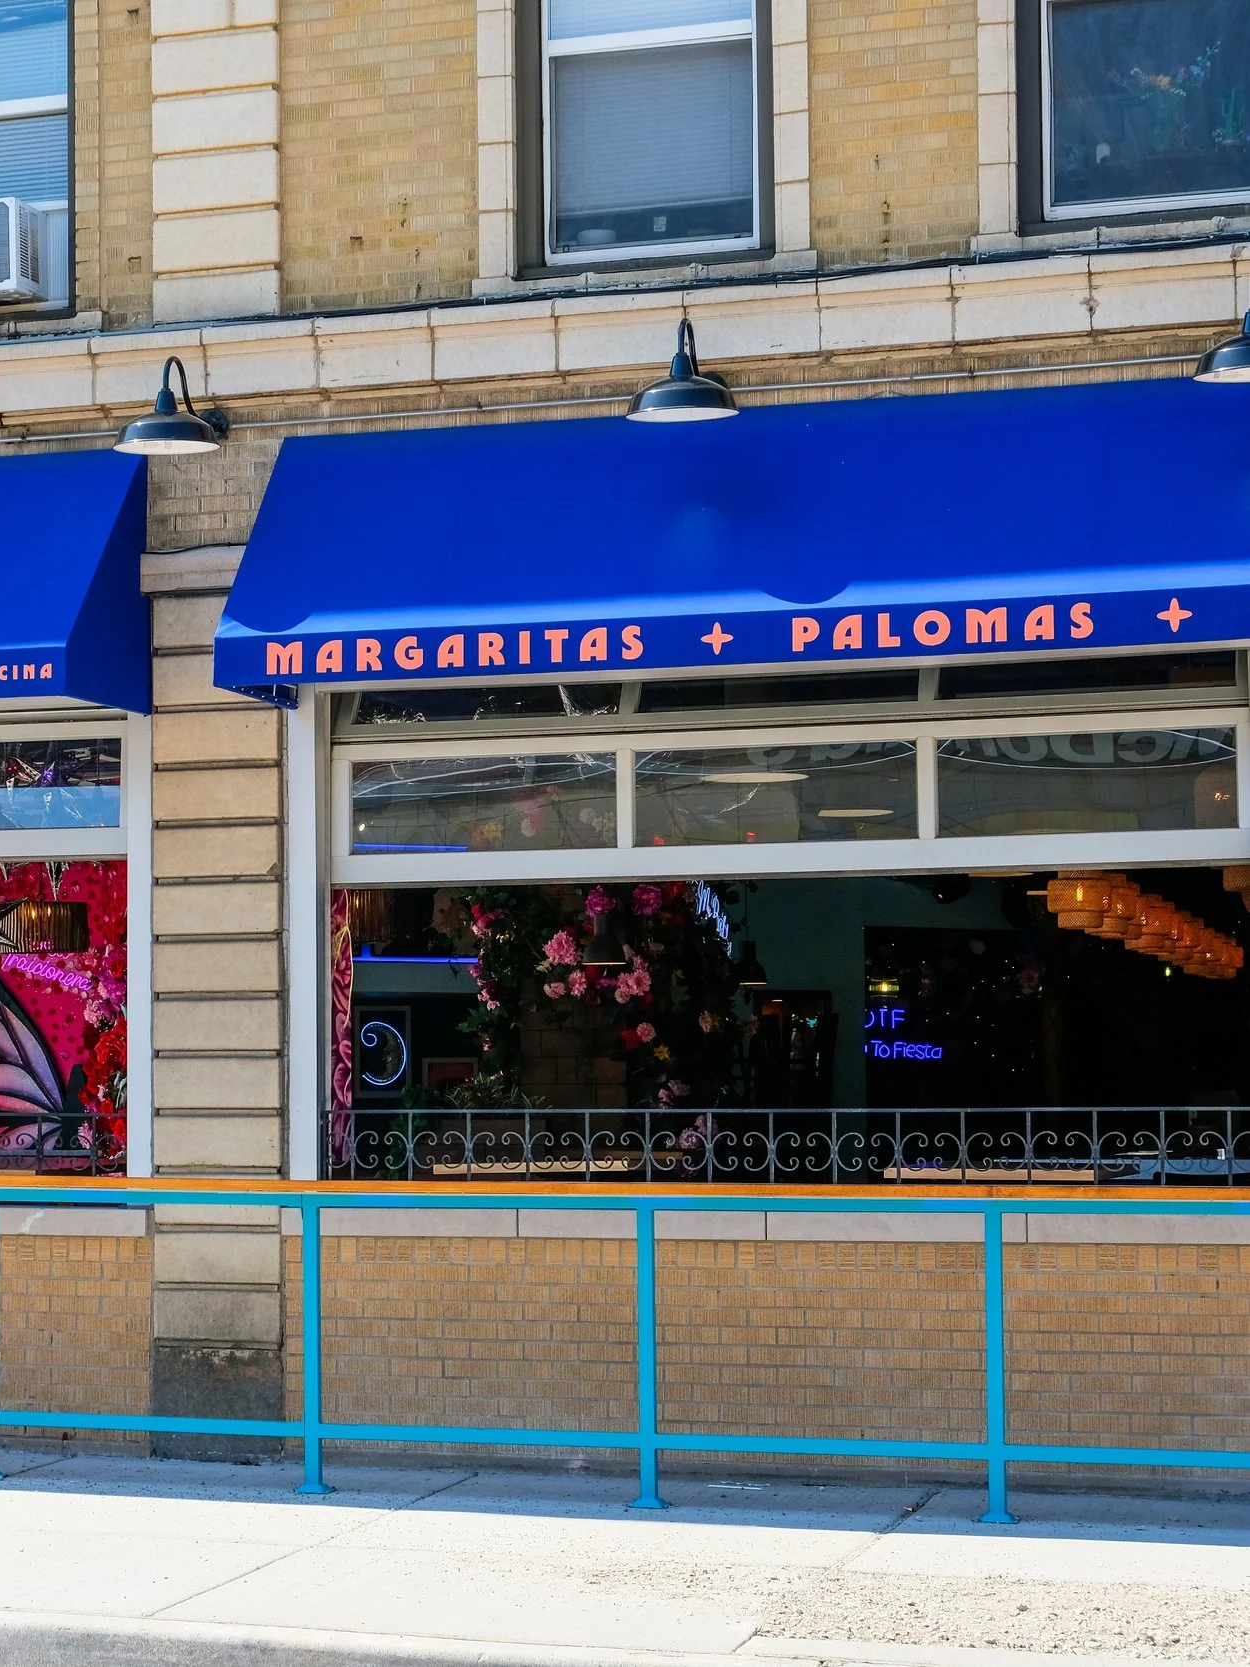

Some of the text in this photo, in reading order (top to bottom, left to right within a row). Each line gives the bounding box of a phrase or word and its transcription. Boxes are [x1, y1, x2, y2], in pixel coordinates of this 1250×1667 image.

[266, 625, 645, 676] MARGARITAS
[791, 602, 1095, 652] PALOMAS
[871, 1040, 890, 1058] To
[893, 1041, 943, 1060] Fiesta
